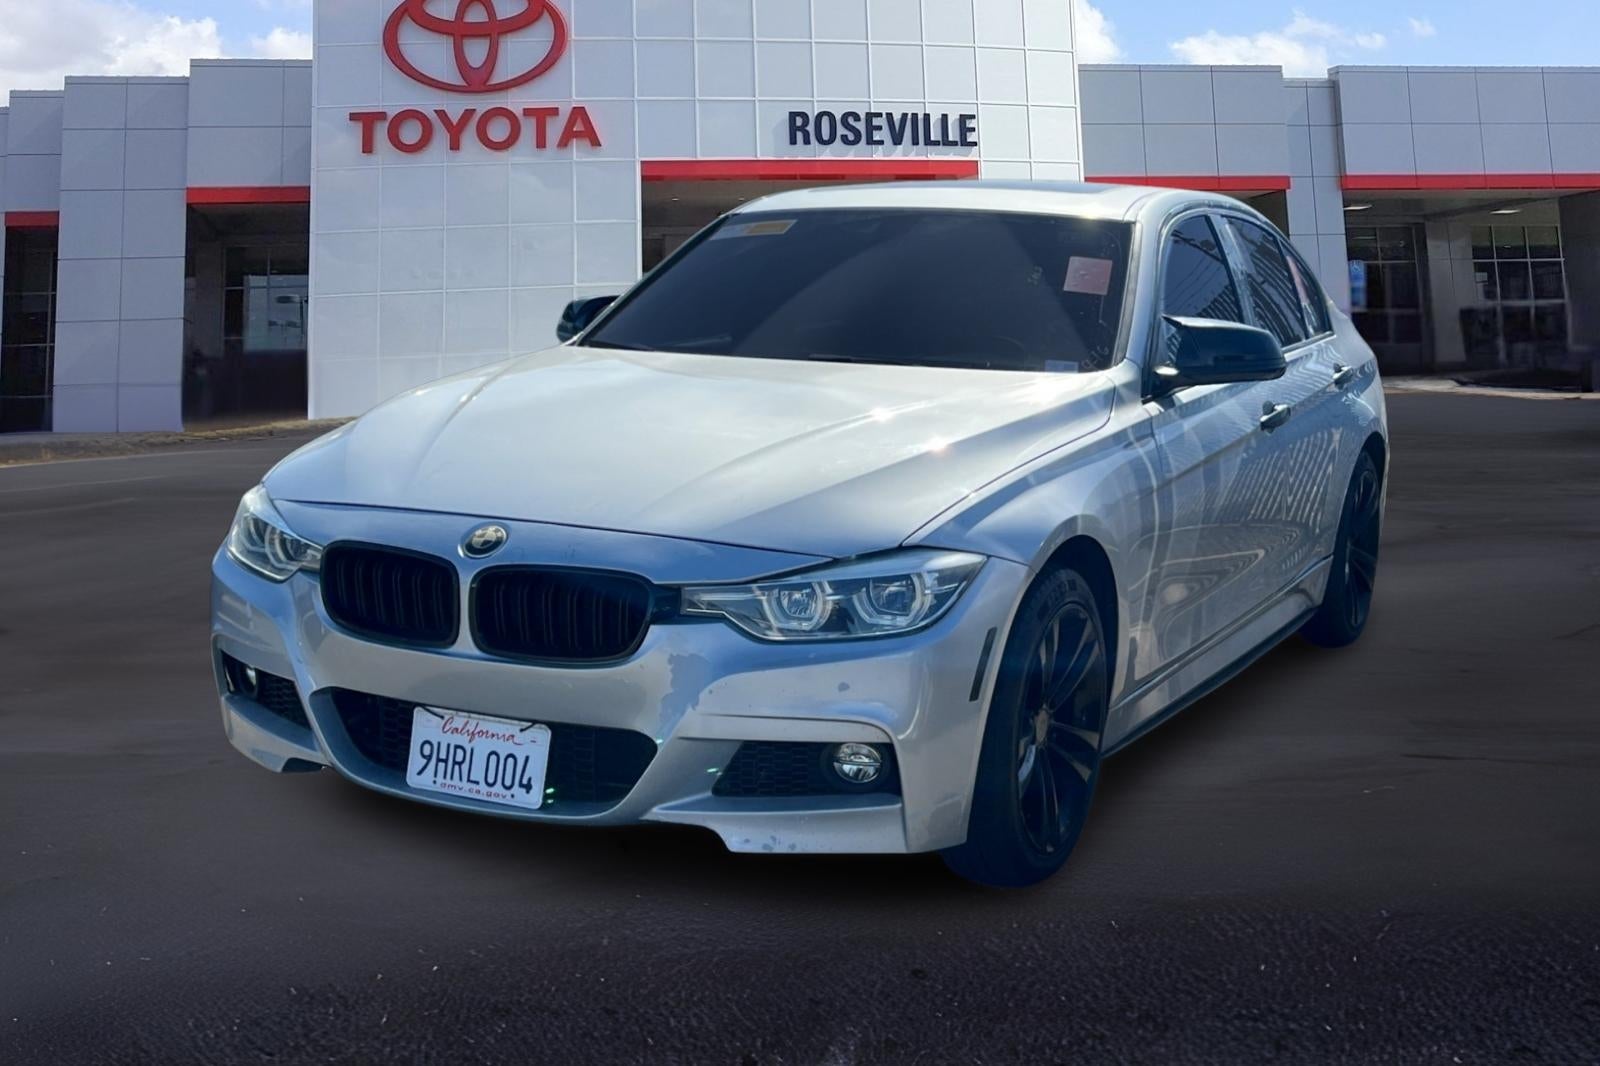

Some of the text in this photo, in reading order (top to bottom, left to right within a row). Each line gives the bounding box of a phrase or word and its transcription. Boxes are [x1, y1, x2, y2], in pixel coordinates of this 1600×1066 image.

[349, 106, 602, 154] TOYOTA
[788, 111, 978, 147] ROSEVILLE
[441, 716, 524, 745] California
[416, 739, 533, 795] 9HRL004
[440, 781, 507, 799] dmv.ca.gov
